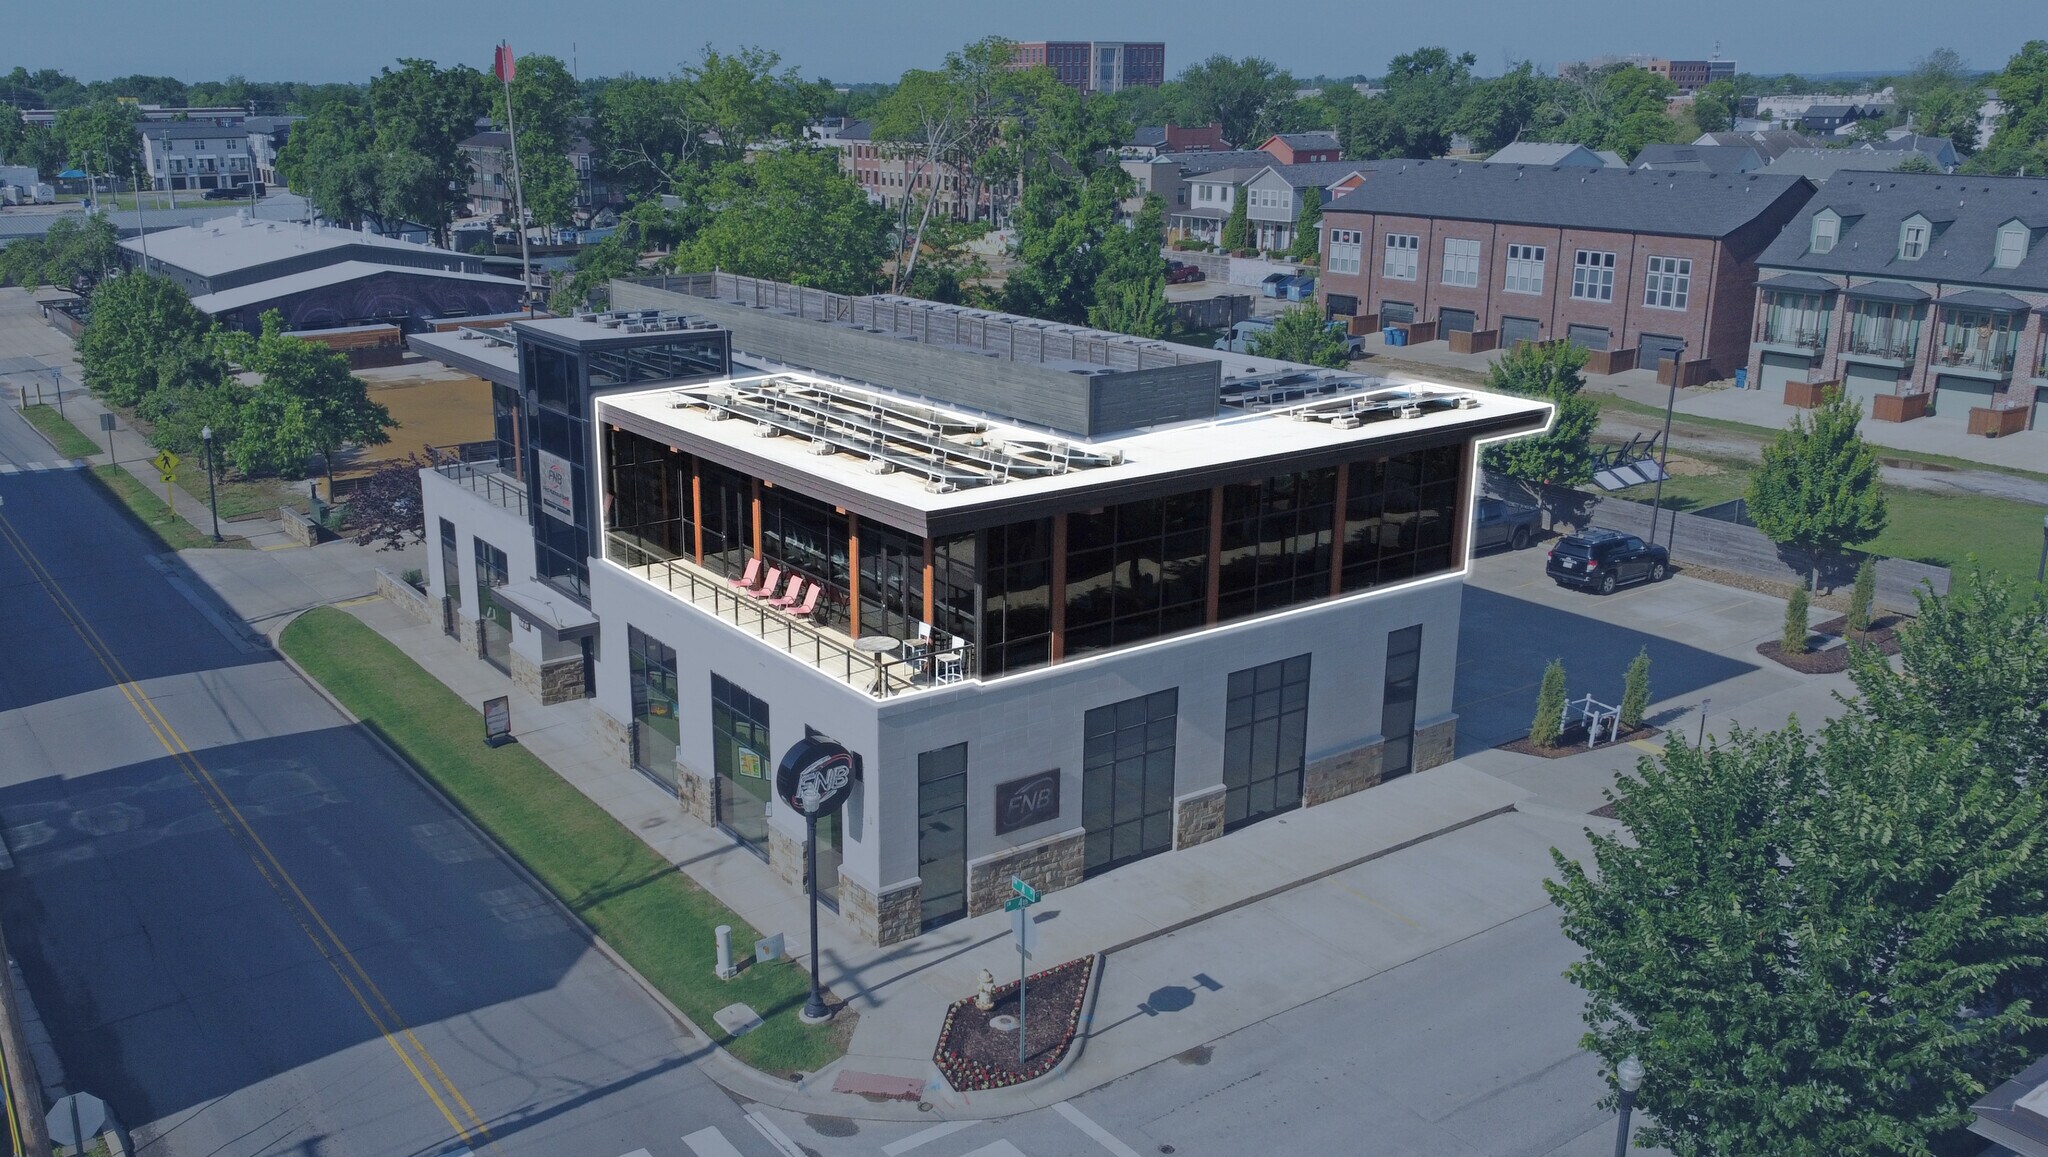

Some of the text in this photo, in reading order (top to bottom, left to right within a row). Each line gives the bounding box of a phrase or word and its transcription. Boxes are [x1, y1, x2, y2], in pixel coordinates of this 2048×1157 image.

[548, 469, 563, 486] FNB
[796, 765, 849, 798] FNB
[1007, 788, 1050, 817] FNB
